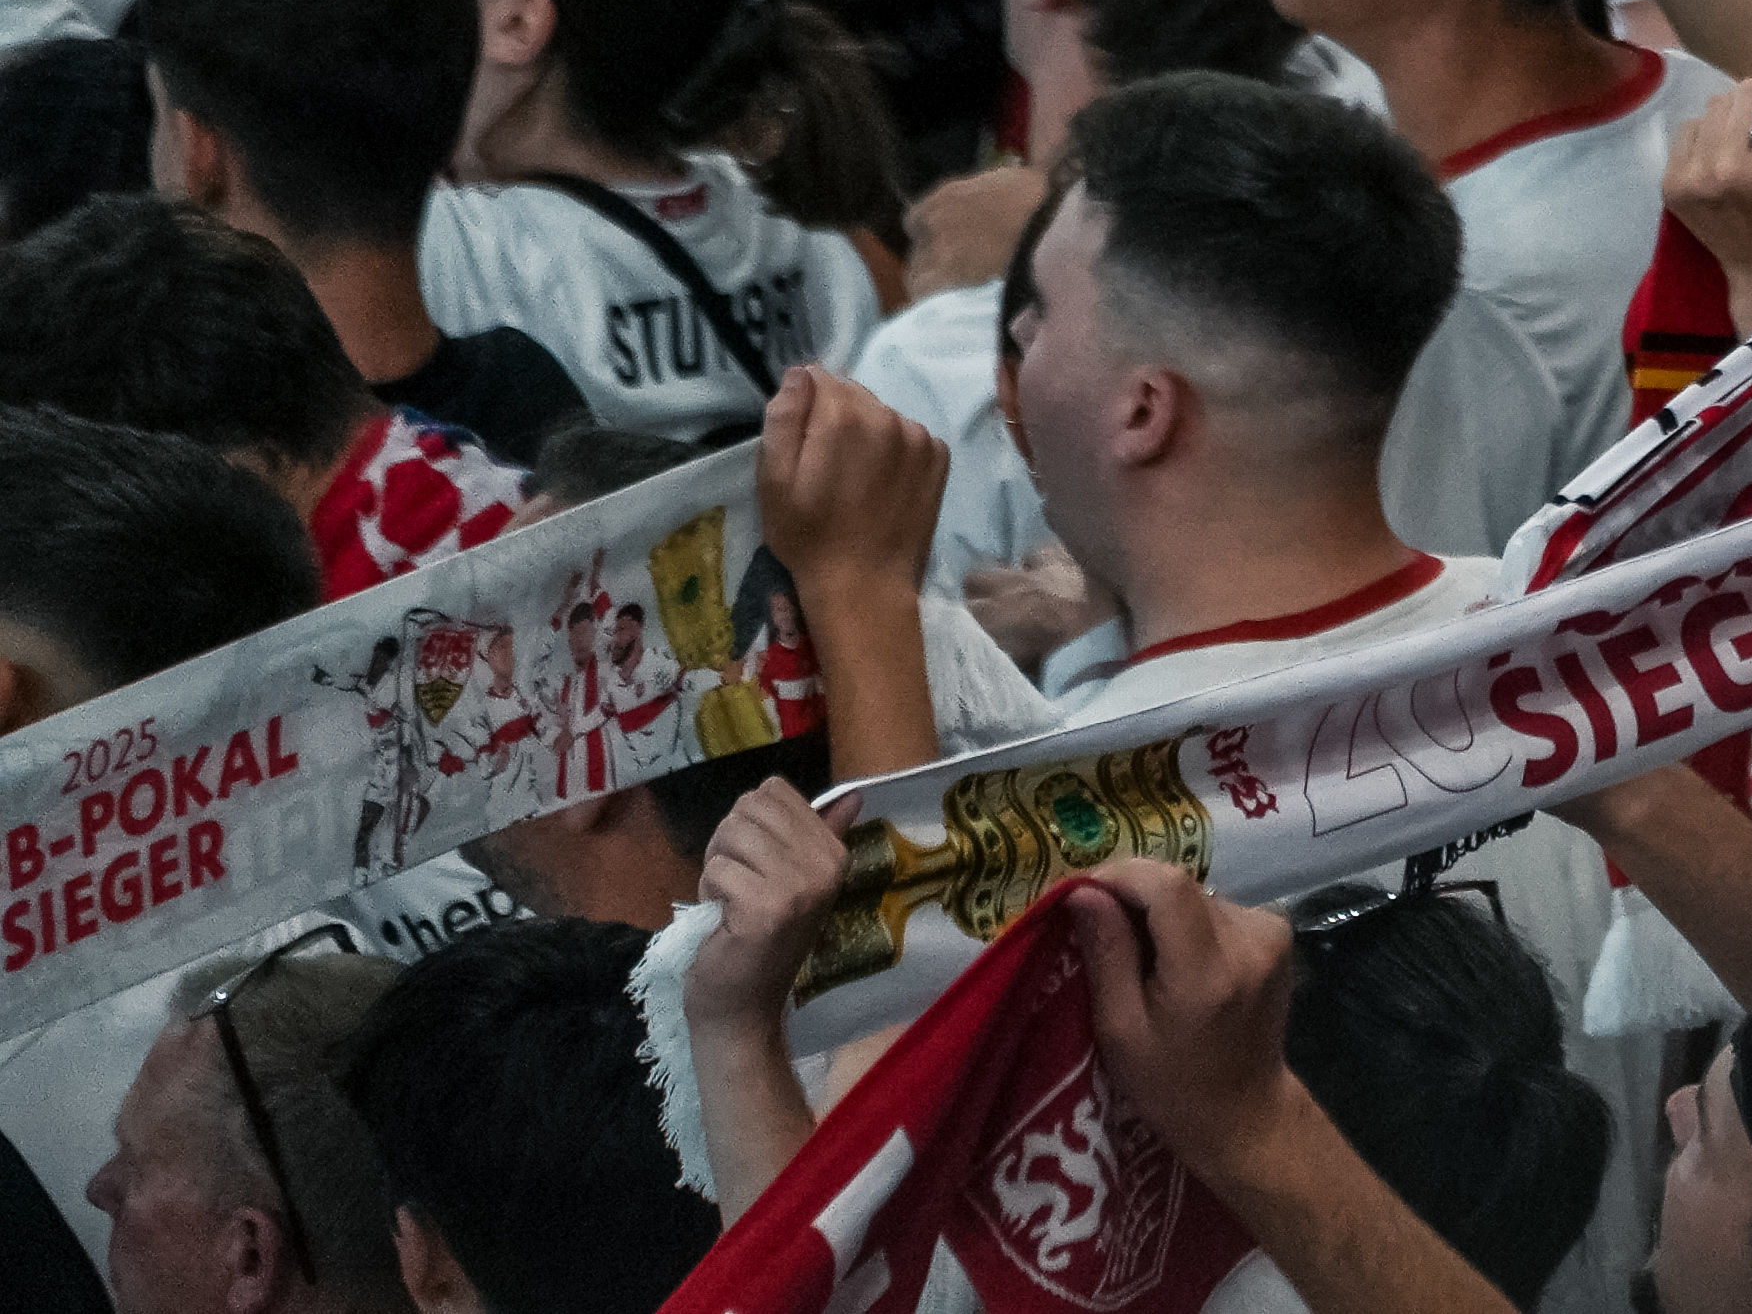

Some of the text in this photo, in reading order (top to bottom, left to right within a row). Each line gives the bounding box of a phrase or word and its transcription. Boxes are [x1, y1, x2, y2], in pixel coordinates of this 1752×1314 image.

[7, 714, 300, 892] B-POKAL
[61, 714, 160, 798] 2025
[0, 818, 230, 978] SIEGER
